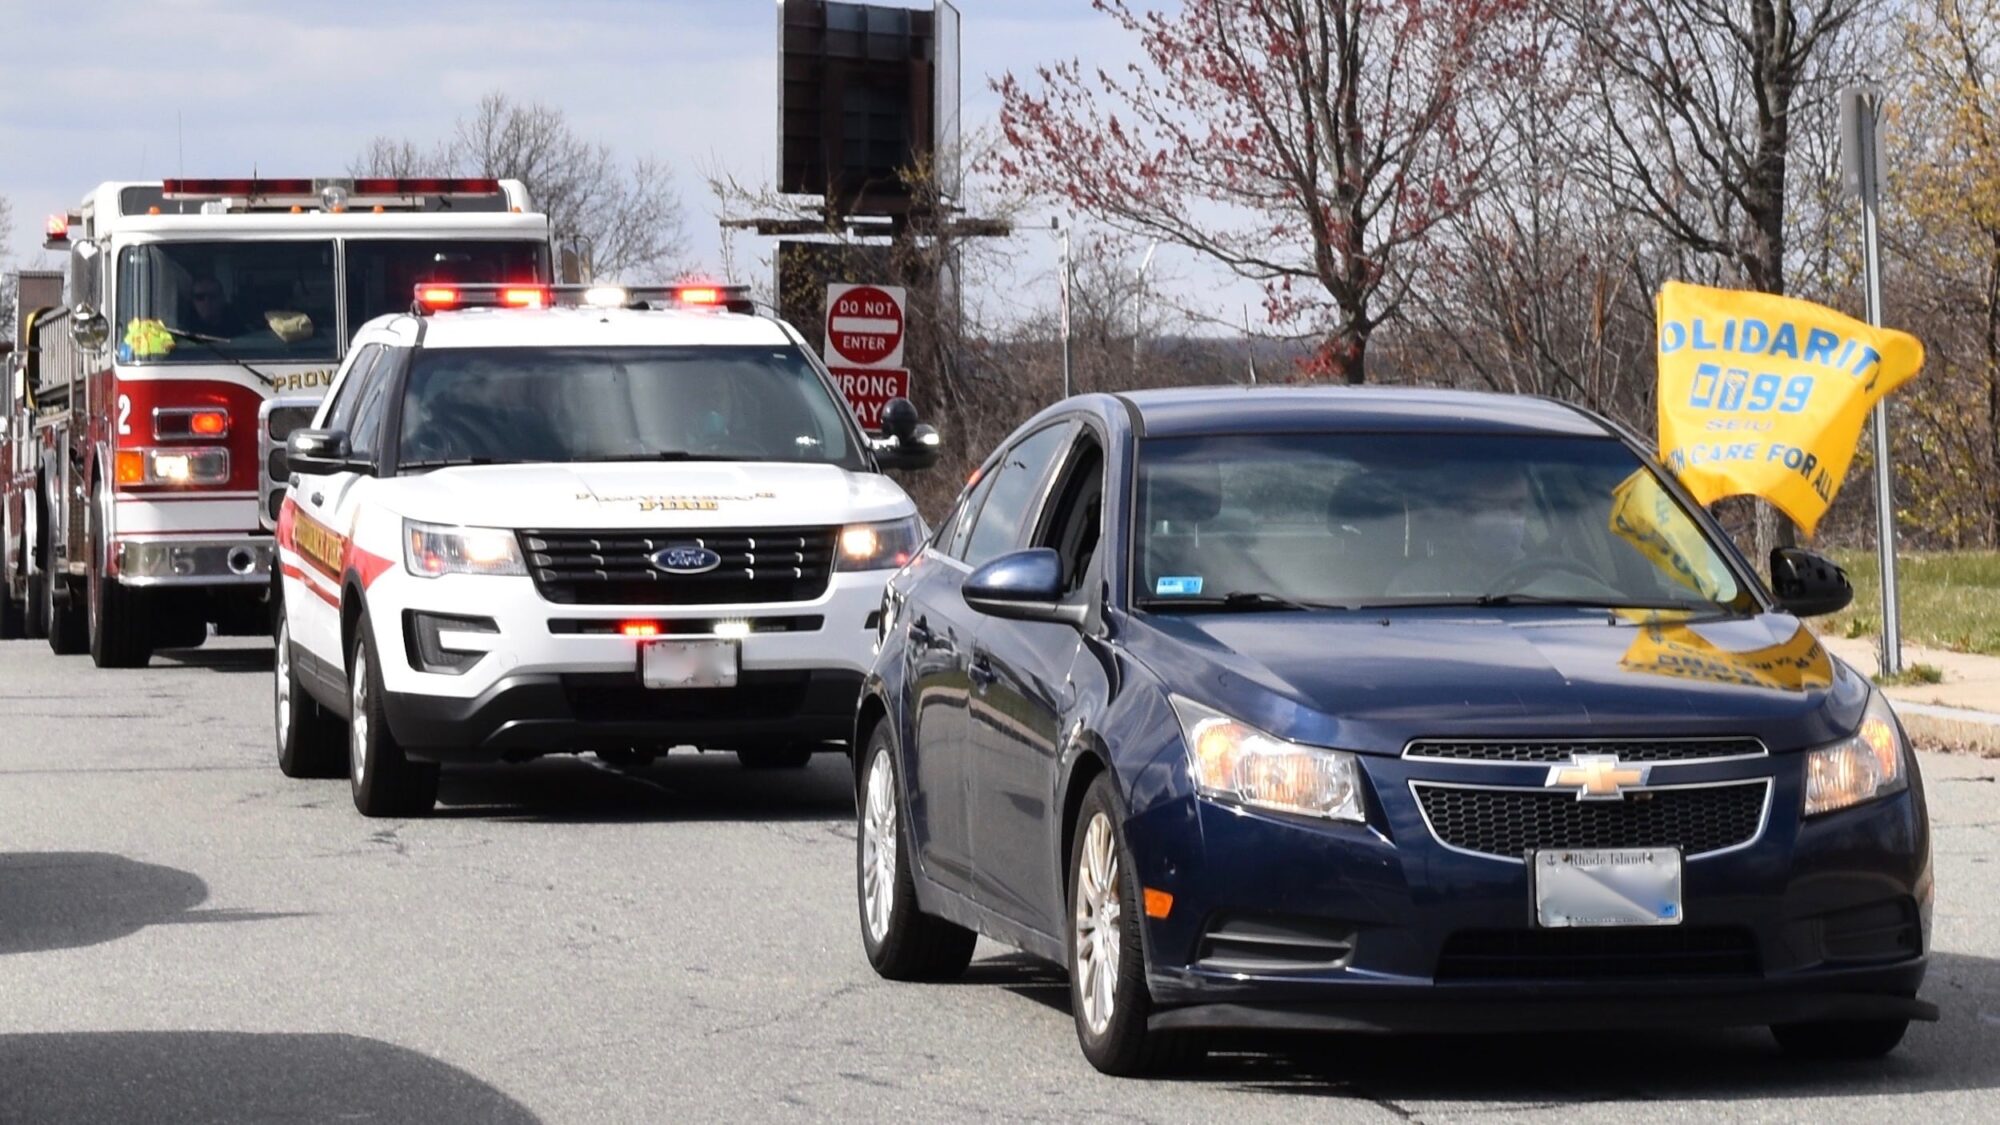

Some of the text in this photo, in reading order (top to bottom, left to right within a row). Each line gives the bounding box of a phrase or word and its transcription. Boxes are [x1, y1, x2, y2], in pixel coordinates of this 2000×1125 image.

[840, 300, 893, 316] DO NOT
[843, 335, 886, 350] ENTER
[1661, 319, 1881, 380] OLIDARIT
[273, 370, 333, 393] PROV
[118, 393, 131, 435] 2
[849, 400, 882, 423] AY
[1690, 443, 1760, 464] CARE
[1767, 443, 1818, 480] FOR
[1811, 466, 1832, 504] ALL
[667, 549, 705, 566] Ford
[1570, 852, 1646, 865] Rhode Island
